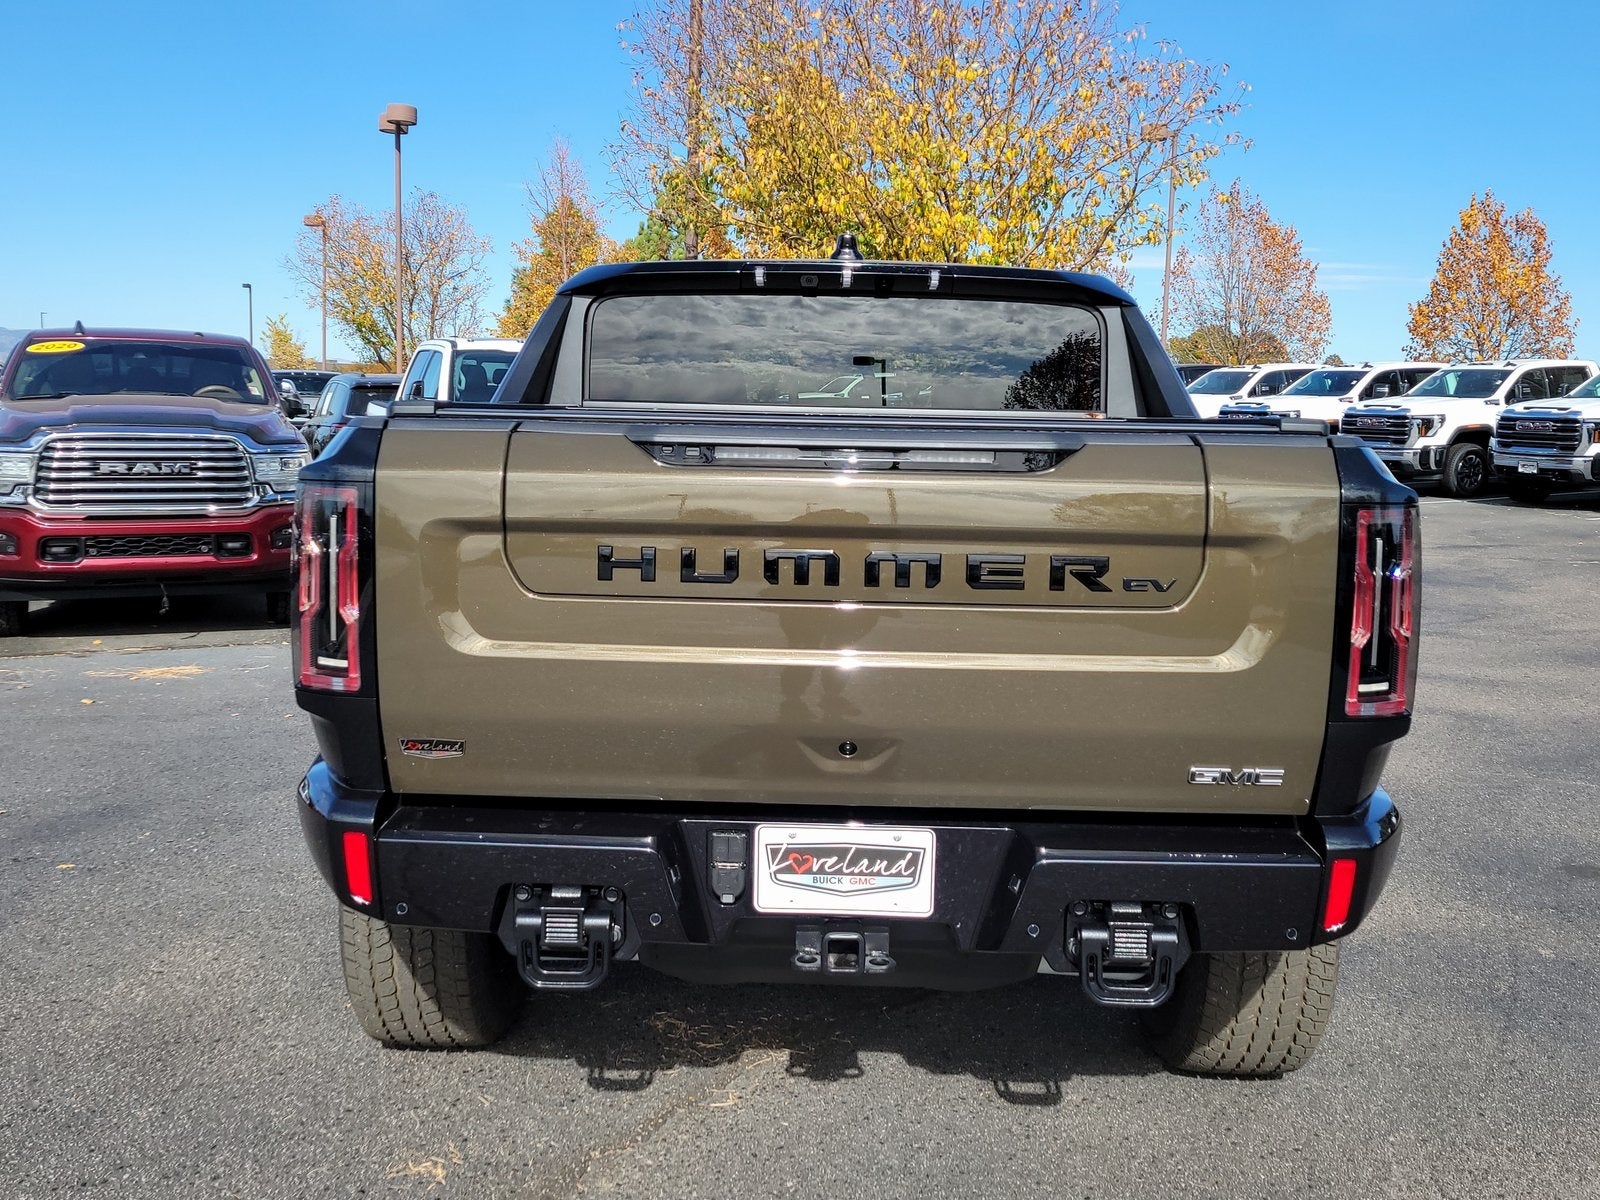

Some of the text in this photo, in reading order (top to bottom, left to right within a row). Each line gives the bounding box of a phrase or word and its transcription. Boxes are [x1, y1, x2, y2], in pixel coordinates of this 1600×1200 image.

[34, 342, 78, 351] 2020
[99, 462, 191, 474] RAM
[597, 545, 1177, 593] HUMMER EV
[1187, 766, 1285, 787] GMC
[768, 843, 915, 876] Loveland
[812, 875, 877, 886] BUICK GMC
